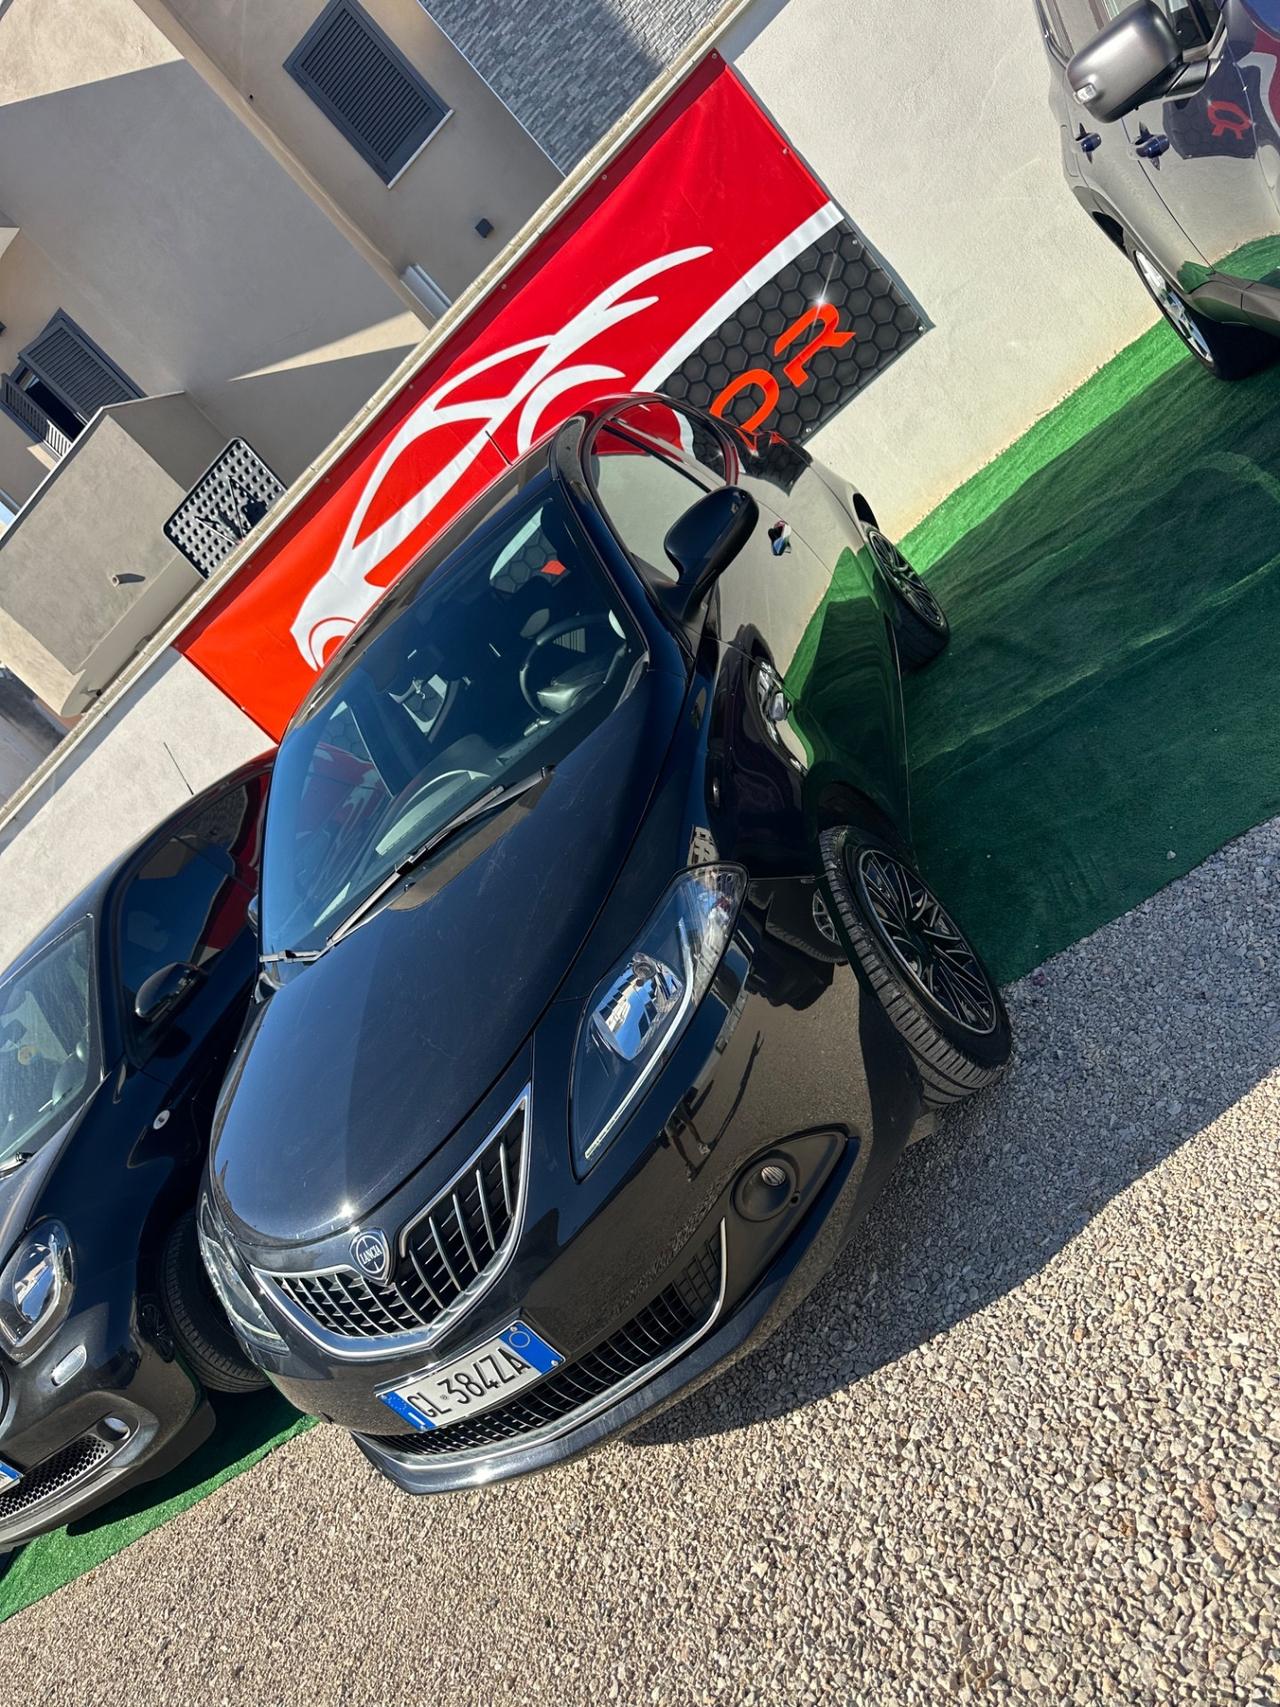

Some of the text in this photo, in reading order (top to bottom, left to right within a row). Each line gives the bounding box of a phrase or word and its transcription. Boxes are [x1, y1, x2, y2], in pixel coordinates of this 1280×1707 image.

[359, 1244, 383, 1265] LANCIA
[406, 1347, 531, 1418] GL 384ZA
